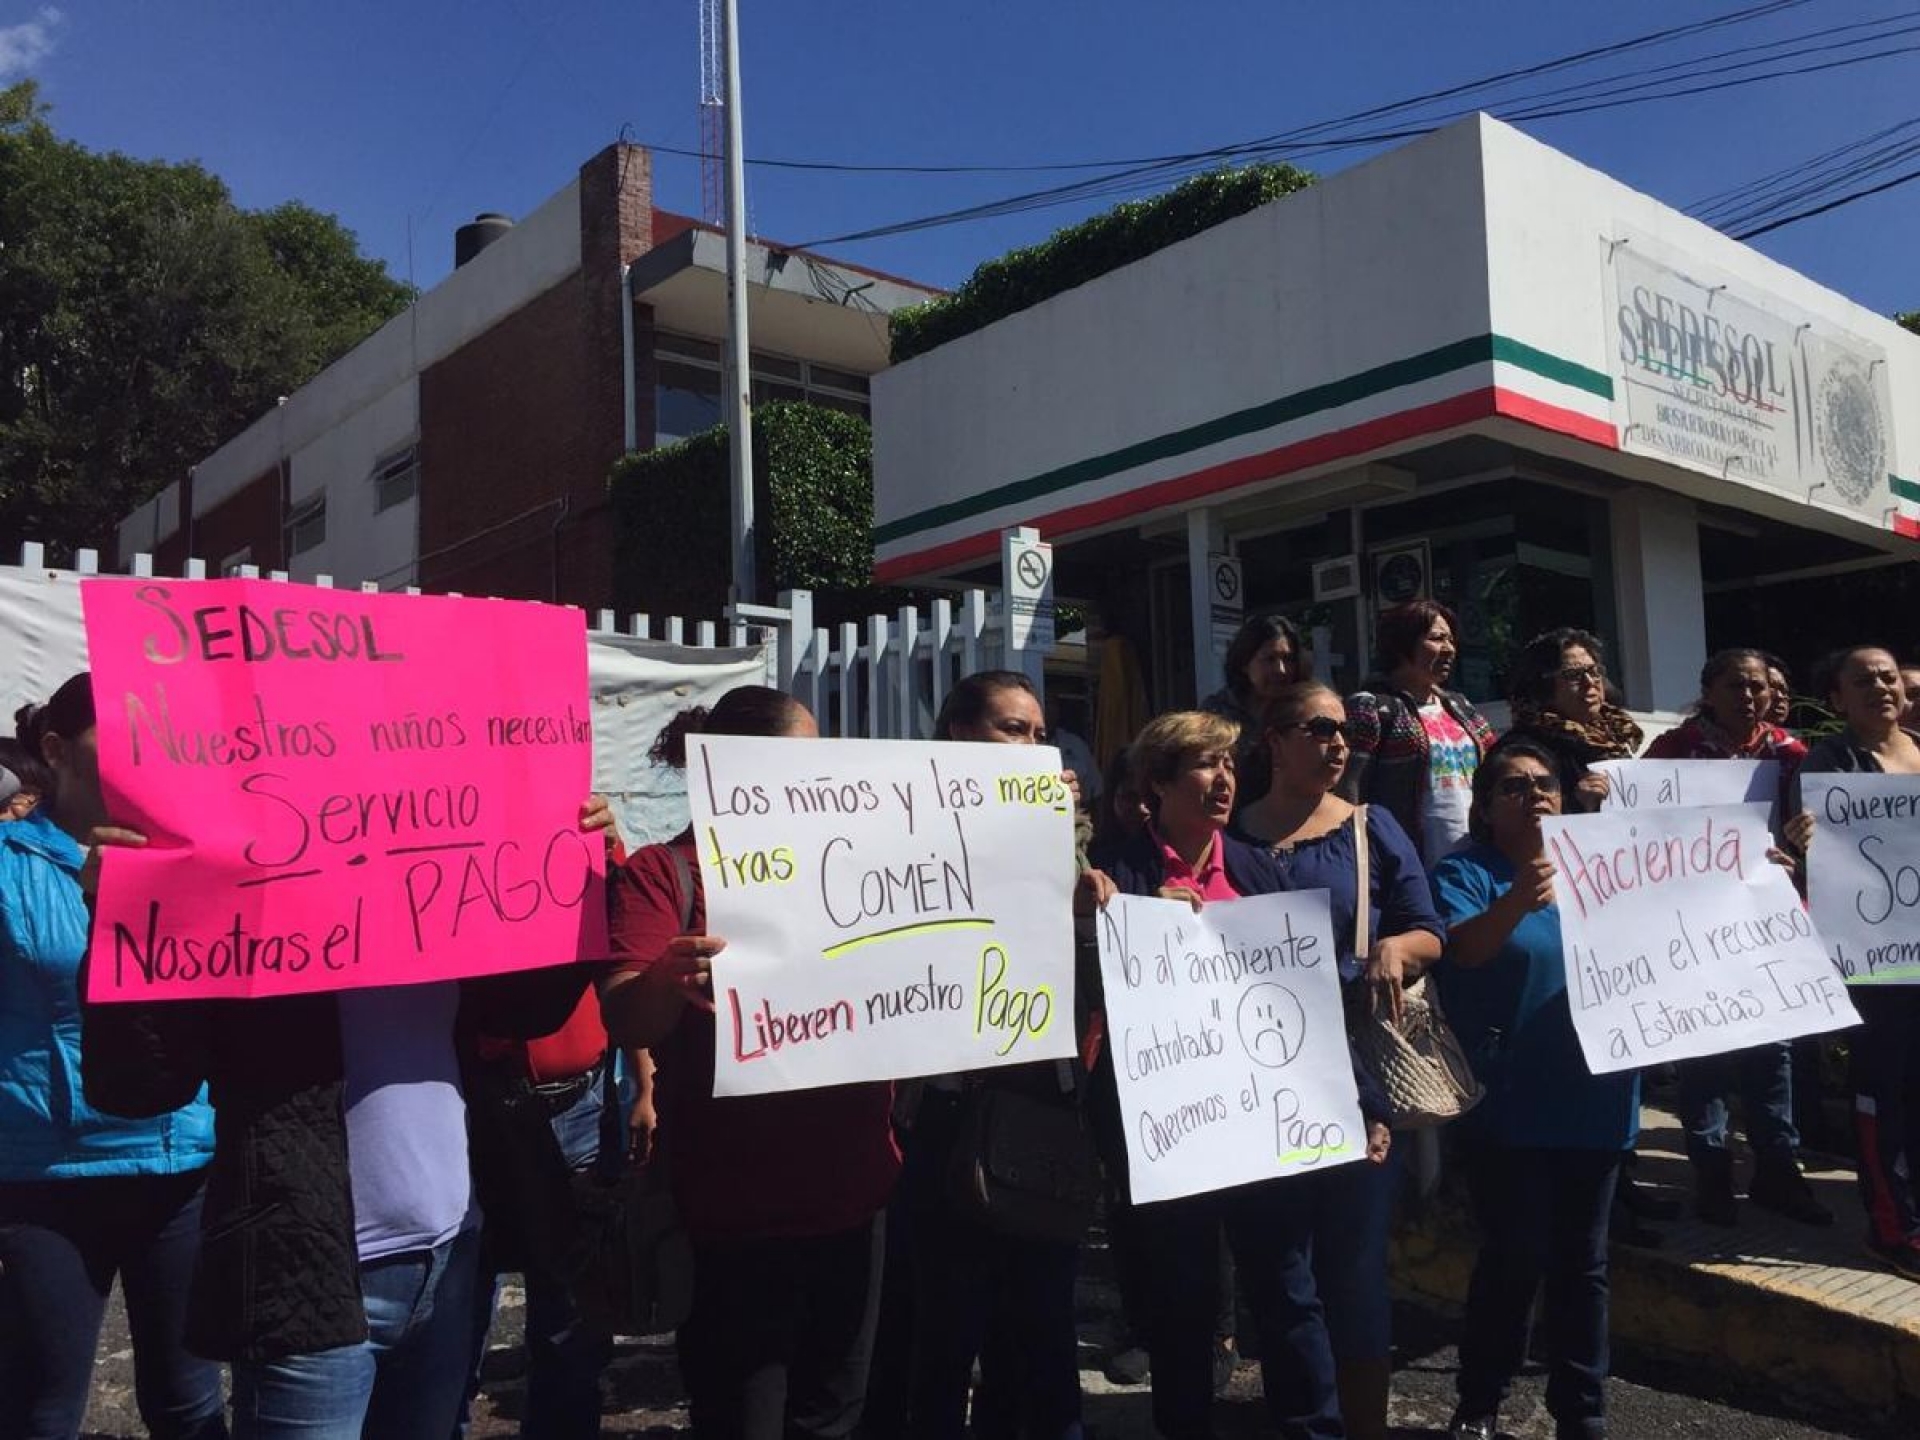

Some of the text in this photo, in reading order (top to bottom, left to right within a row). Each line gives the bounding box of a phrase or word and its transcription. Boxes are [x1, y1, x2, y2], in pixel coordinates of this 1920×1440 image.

[1633, 285, 1785, 398] SEDESOL
[135, 586, 405, 665] SEDESOL
[125, 681, 337, 767] Nuestros
[370, 711, 467, 753] niños
[240, 772, 481, 868] Servicio
[701, 743, 770, 817] Los
[784, 777, 880, 815] niños
[892, 779, 914, 835] y
[930, 757, 985, 810] las
[1604, 766, 1681, 809] No al
[708, 825, 794, 889] tras
[1550, 817, 1745, 919] Hacienda
[1856, 834, 1920, 925] So
[114, 828, 592, 988] Nosotras el PAGO
[1104, 899, 1142, 991] No
[1154, 932, 1177, 987] al
[728, 945, 1053, 1063] Liberen nuestro Pago
[1572, 907, 1812, 1012] Libera el recurso
[1608, 1027, 1633, 1060] a
[1631, 987, 1765, 1049] Estancias
[1139, 1072, 1345, 1165] Queremos el Pago
